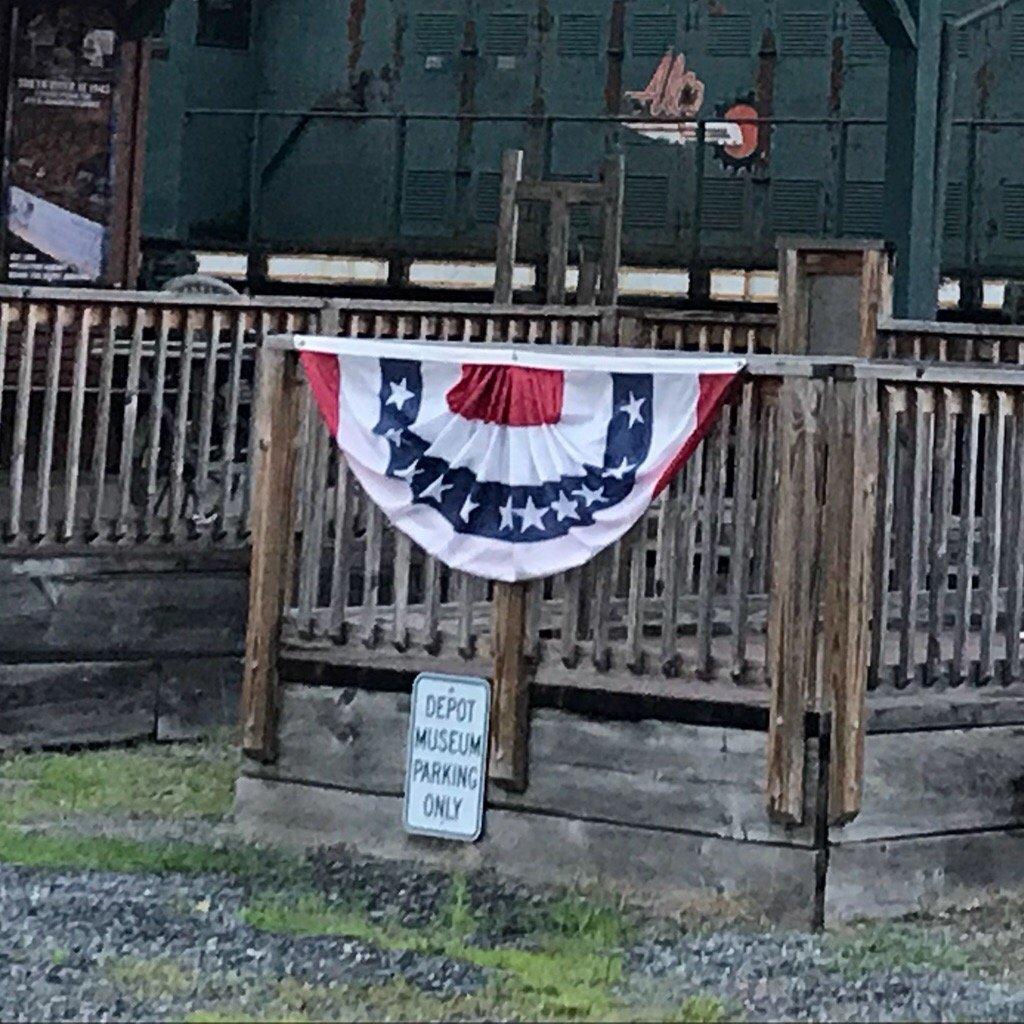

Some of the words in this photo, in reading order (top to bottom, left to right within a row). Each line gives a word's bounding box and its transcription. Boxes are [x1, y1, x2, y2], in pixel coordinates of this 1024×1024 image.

[425, 694, 476, 723] DEPOT
[415, 728, 482, 756] MUSEUM
[412, 758, 478, 791] PARKING
[422, 792, 464, 821] ONLY
